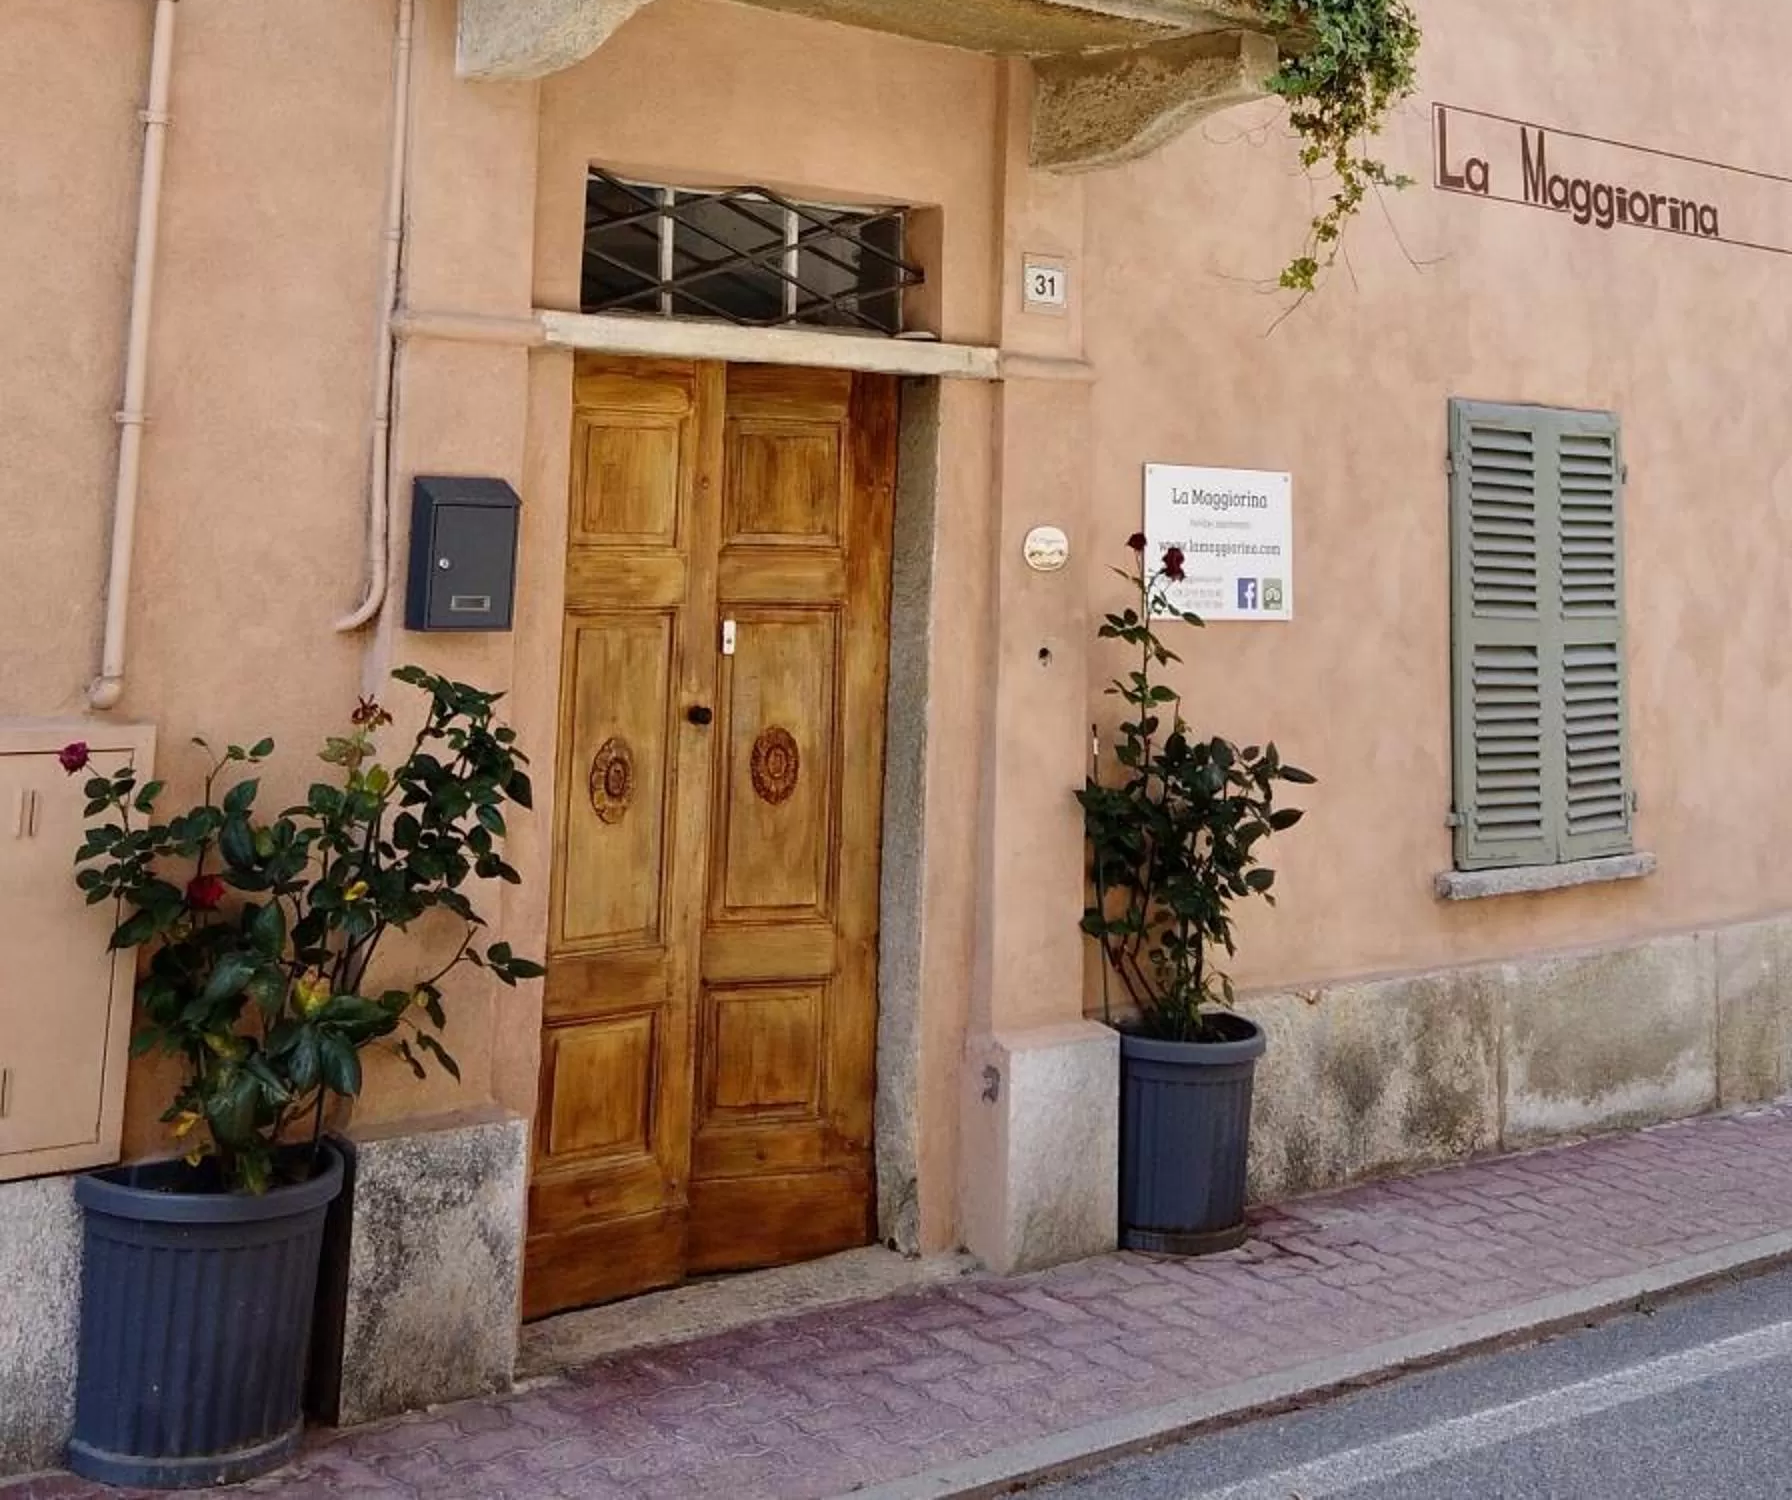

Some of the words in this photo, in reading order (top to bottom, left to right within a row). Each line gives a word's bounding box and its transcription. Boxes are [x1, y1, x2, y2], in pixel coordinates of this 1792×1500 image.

[1437, 107, 1489, 194] La
[1519, 125, 1720, 236] Maggiorina
[1034, 274, 1055, 297] 31
[1172, 487, 1188, 505] La
[1191, 489, 1268, 511] Maggiorina
